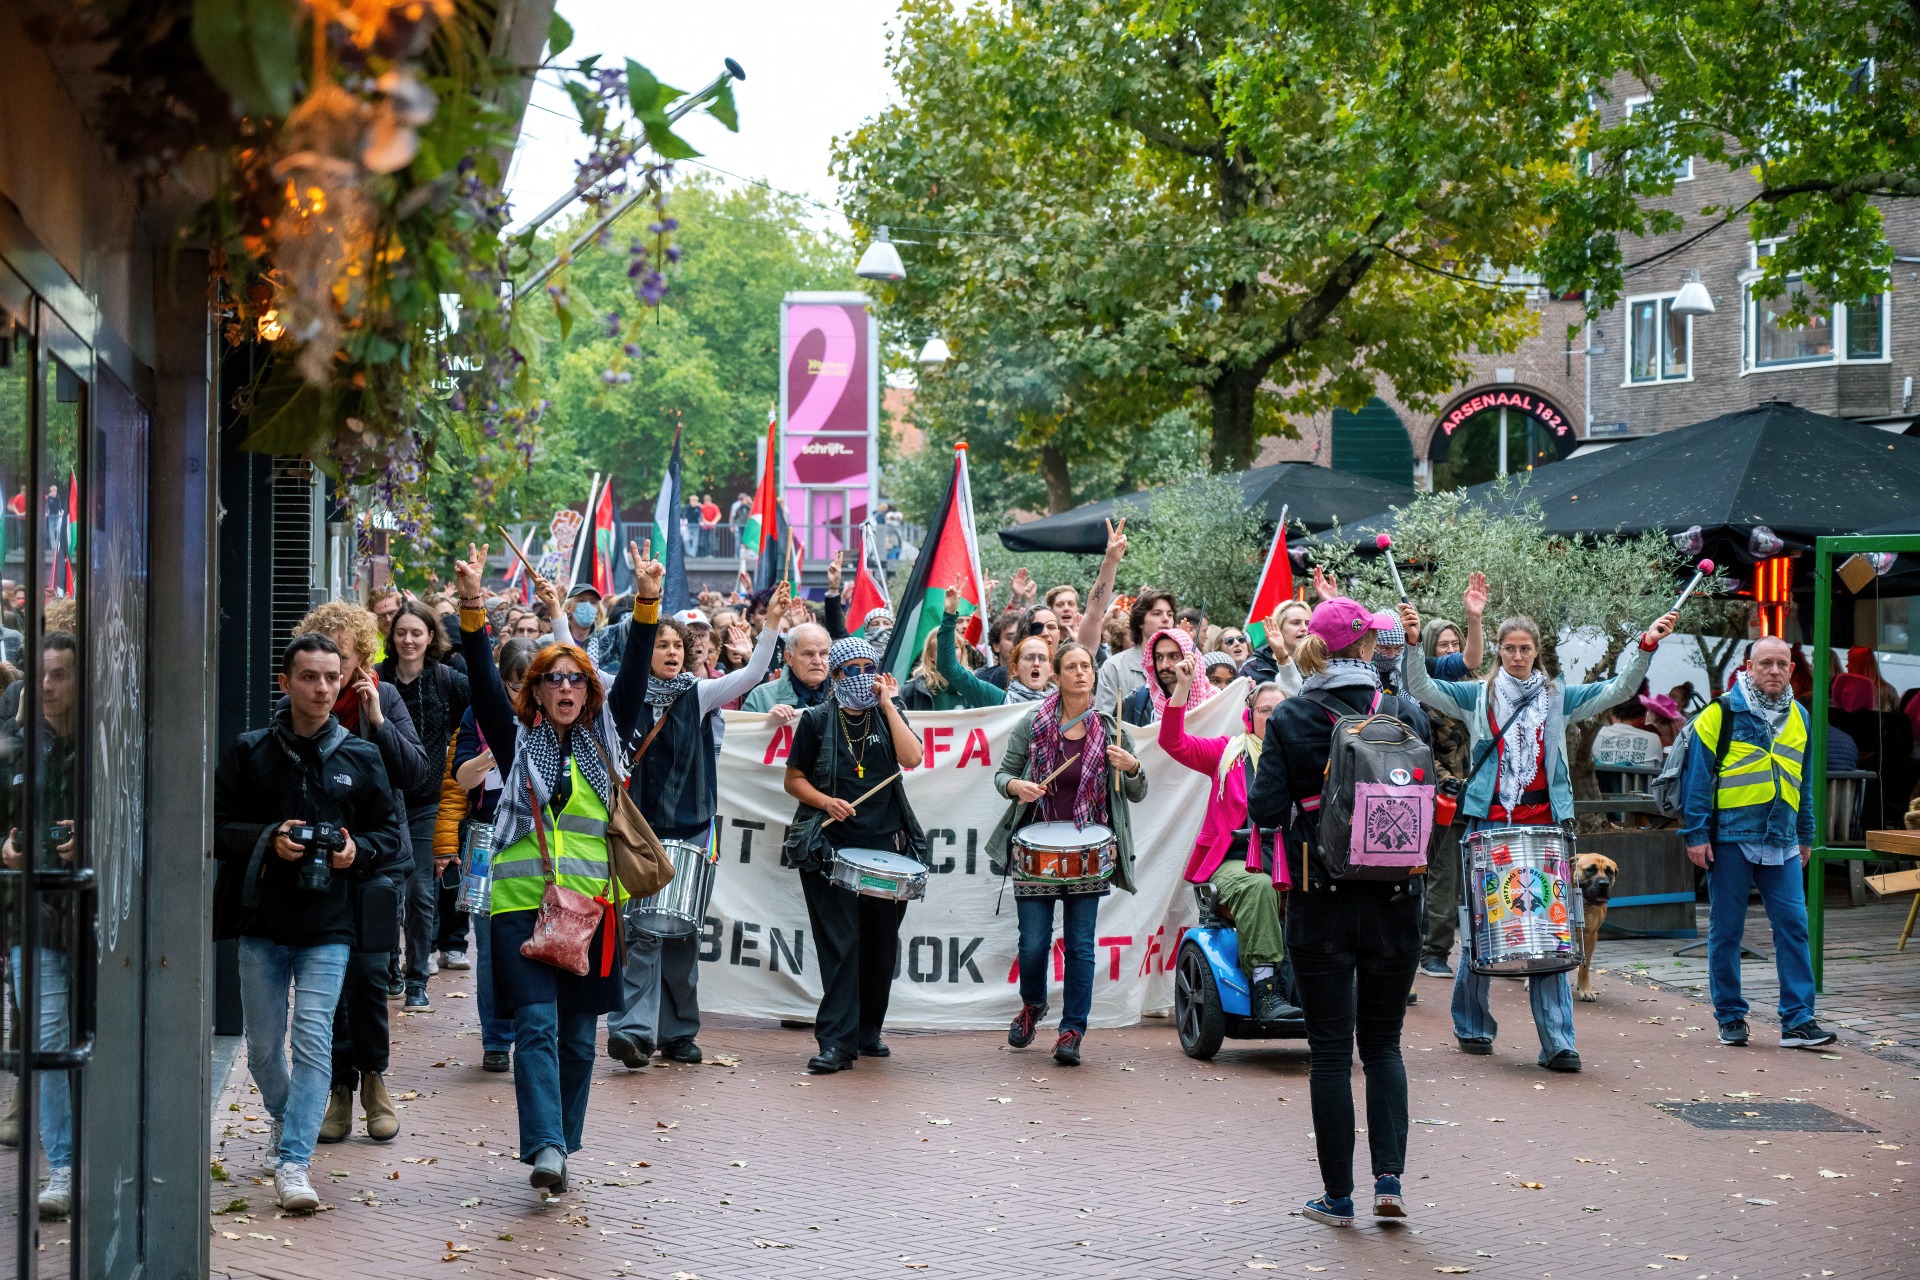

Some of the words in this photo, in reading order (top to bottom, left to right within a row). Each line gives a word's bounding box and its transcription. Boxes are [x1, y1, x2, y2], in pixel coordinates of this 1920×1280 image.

[1442, 392, 1532, 436] ARSENAAL
[1534, 401, 1569, 437] 1824
[1368, 803, 1385, 839] RHYTHMS
[1399, 800, 1418, 840] RESISTANCE
[1503, 872, 1516, 904] RHYTHMS
[1530, 868, 1549, 903] RESISTANCE
[893, 935, 985, 984] OK
